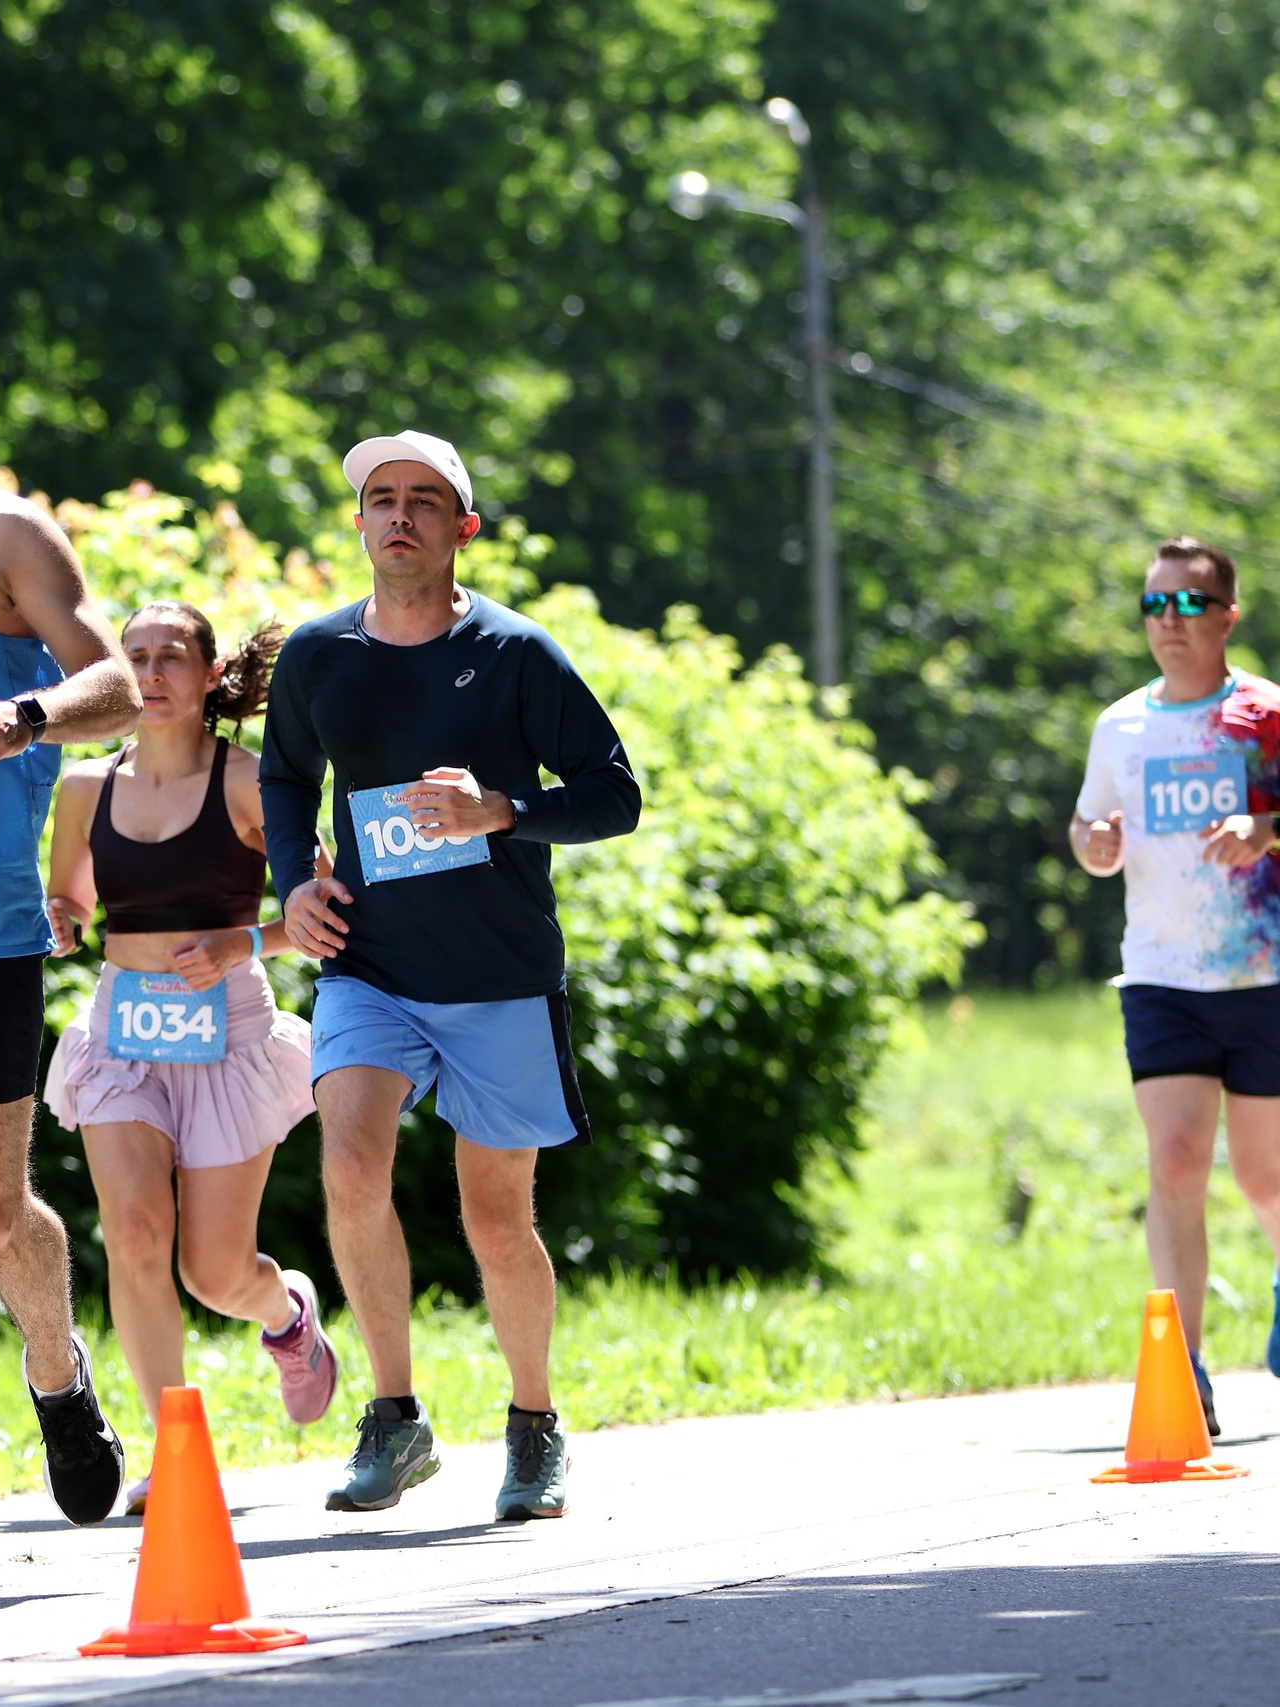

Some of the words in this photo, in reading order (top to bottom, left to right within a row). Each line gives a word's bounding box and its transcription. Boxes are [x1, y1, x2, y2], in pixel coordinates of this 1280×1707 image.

[1150, 777, 1238, 817] 1106
[363, 816, 472, 860] 108
[117, 1000, 218, 1044] 1034
